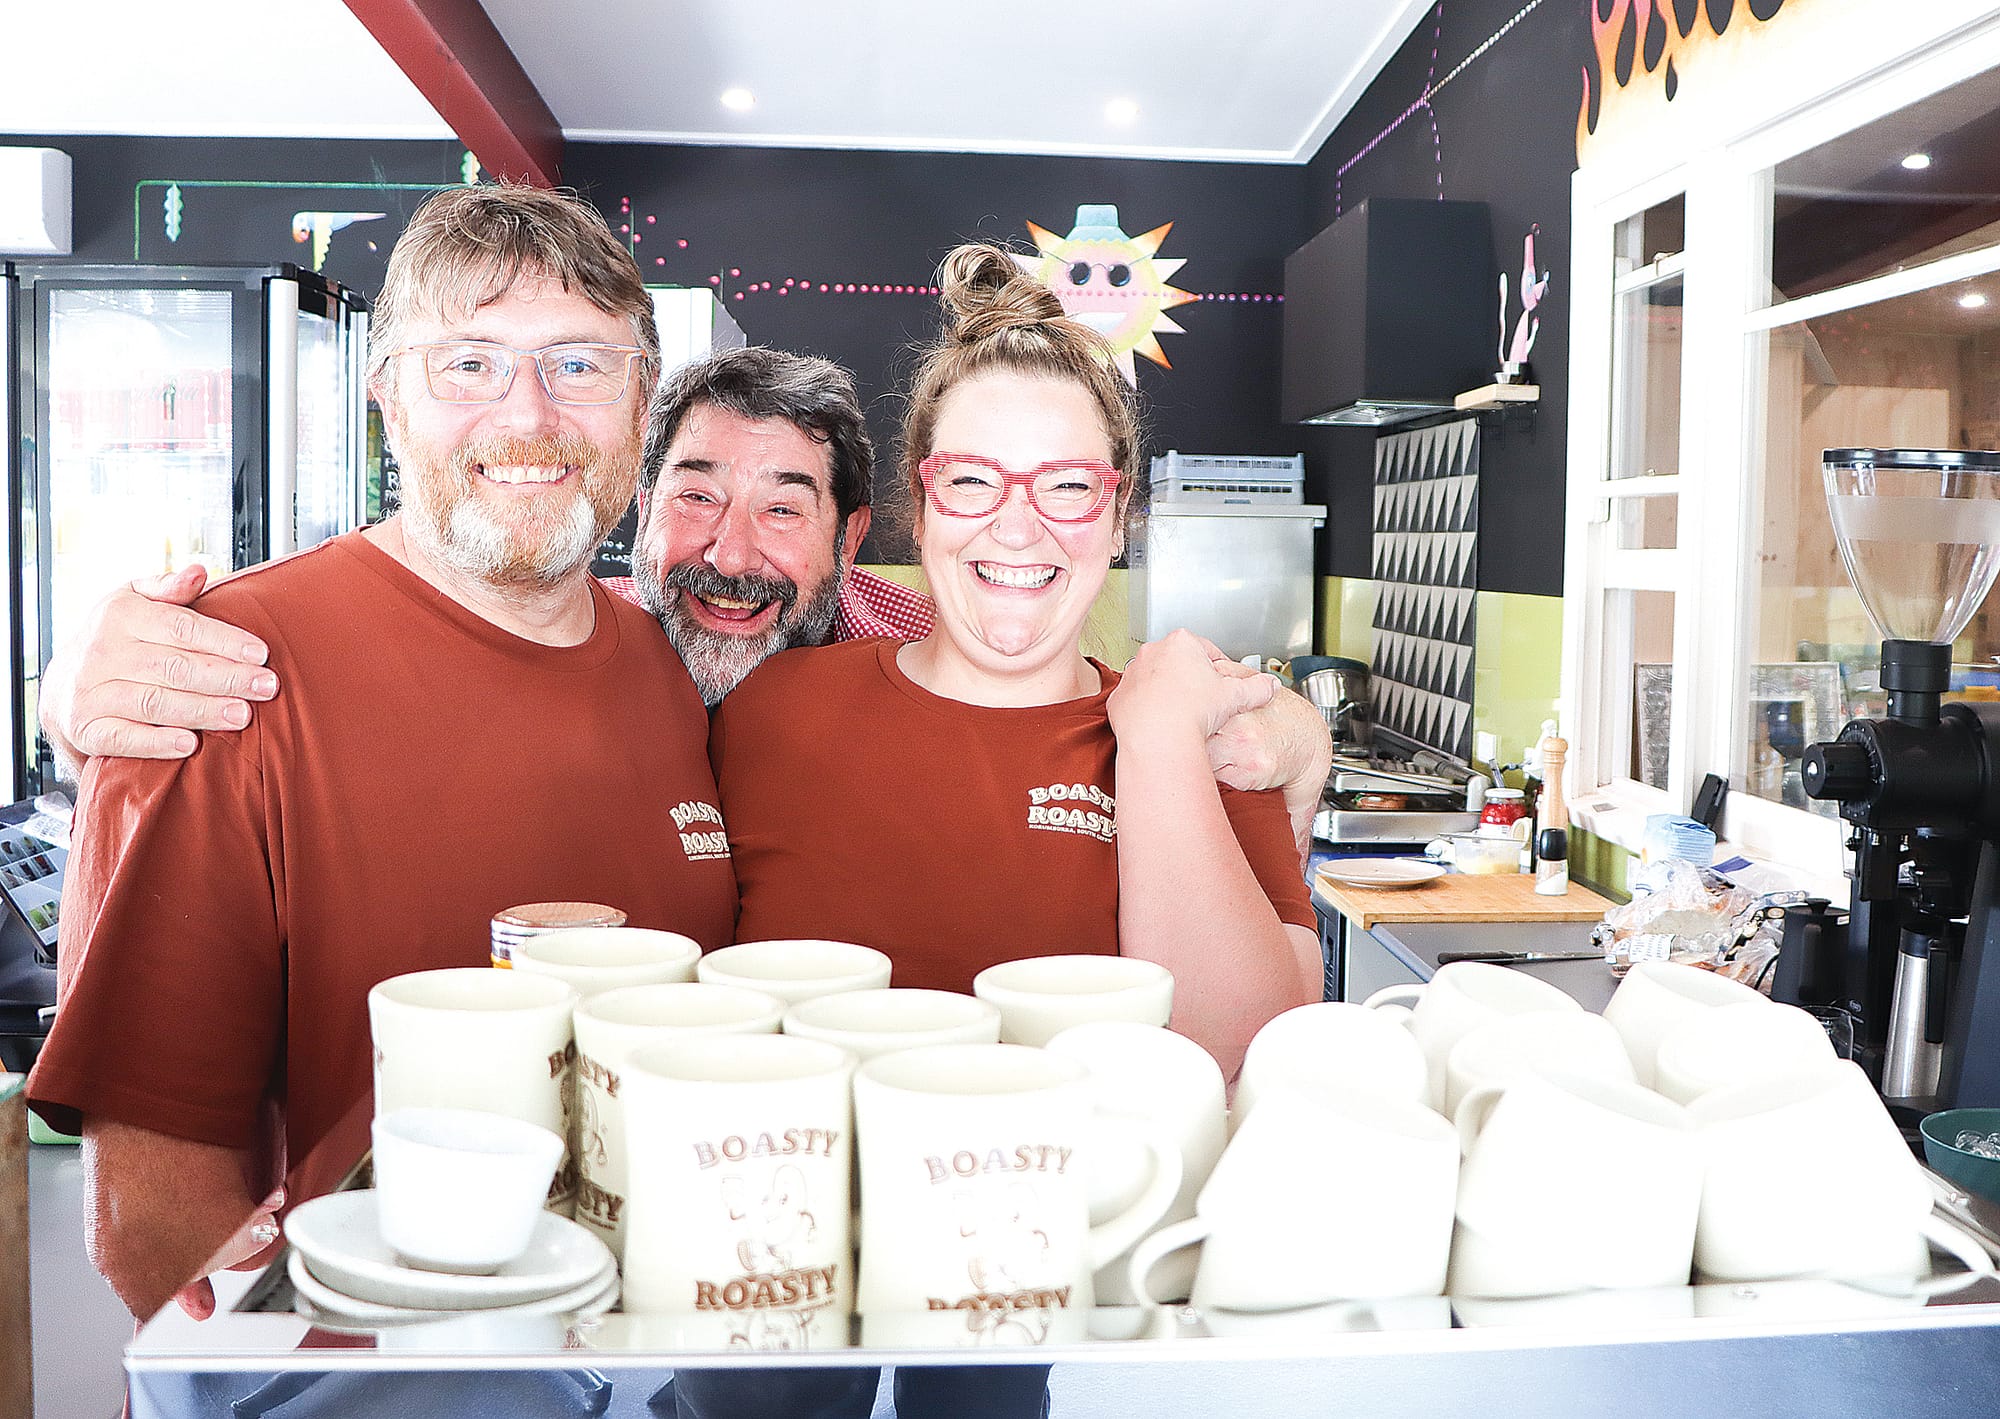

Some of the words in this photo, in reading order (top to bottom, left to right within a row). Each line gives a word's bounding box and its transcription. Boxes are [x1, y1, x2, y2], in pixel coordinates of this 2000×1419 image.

[1028, 783, 1118, 813] BOAST
[1027, 805, 1118, 838] ROAST
[679, 831, 730, 855] ROAST
[693, 1127, 840, 1170] BOASTY
[924, 1144, 1073, 1185] BOASTY
[695, 1264, 838, 1311] ROASTY
